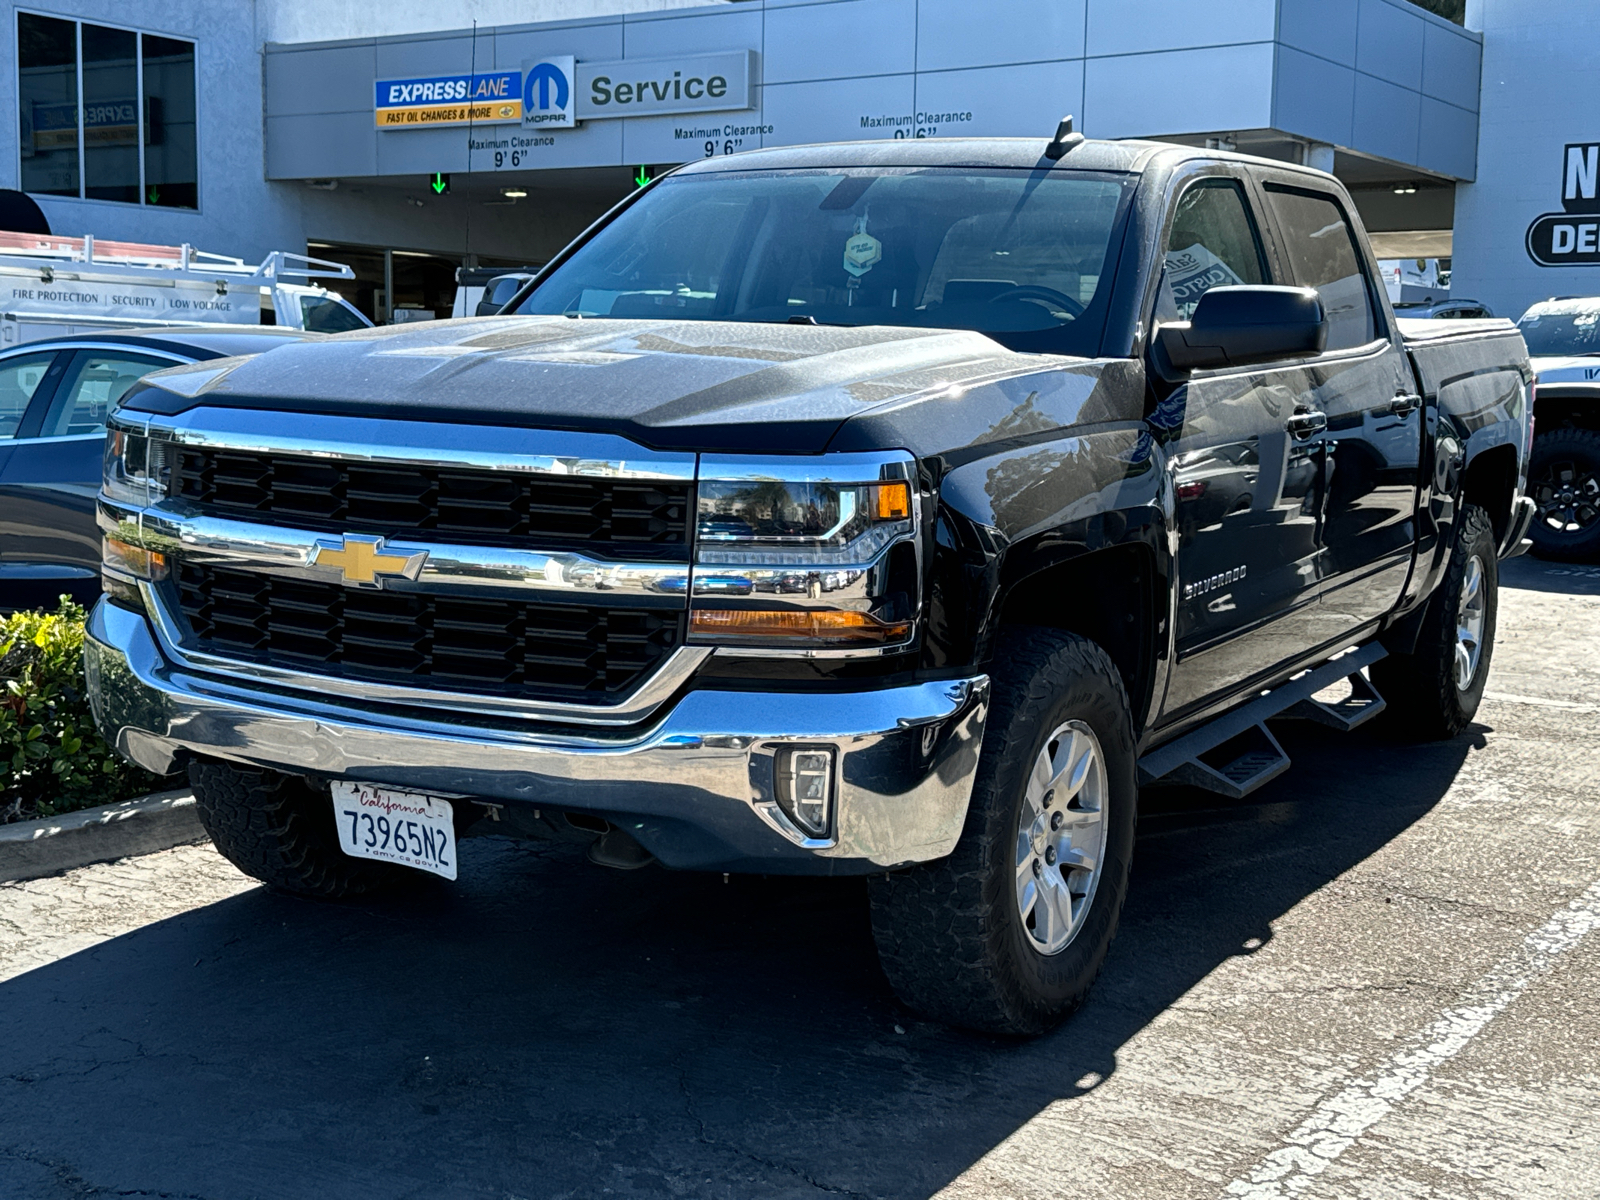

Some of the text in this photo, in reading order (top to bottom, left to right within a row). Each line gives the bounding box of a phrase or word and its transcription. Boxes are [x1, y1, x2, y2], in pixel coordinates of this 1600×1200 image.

[590, 70, 727, 106] Service
[386, 112, 406, 123] FAST
[407, 111, 418, 122] OIL
[420, 109, 457, 121] CHANGES
[458, 109, 465, 119] &
[467, 107, 492, 119] MORE
[525, 113, 567, 123] MOPAR
[860, 111, 973, 128] Maximum Clearance
[468, 136, 555, 150] Maximum Clearance
[674, 124, 774, 140] Maximum Clearance
[1551, 223, 1600, 254] DE
[12, 289, 231, 312] FIRE PROTECTION SECURITY LOW VOLTAGE
[1184, 564, 1247, 600] SILVERADO
[360, 790, 434, 819] California
[343, 810, 449, 867] 73965N2
